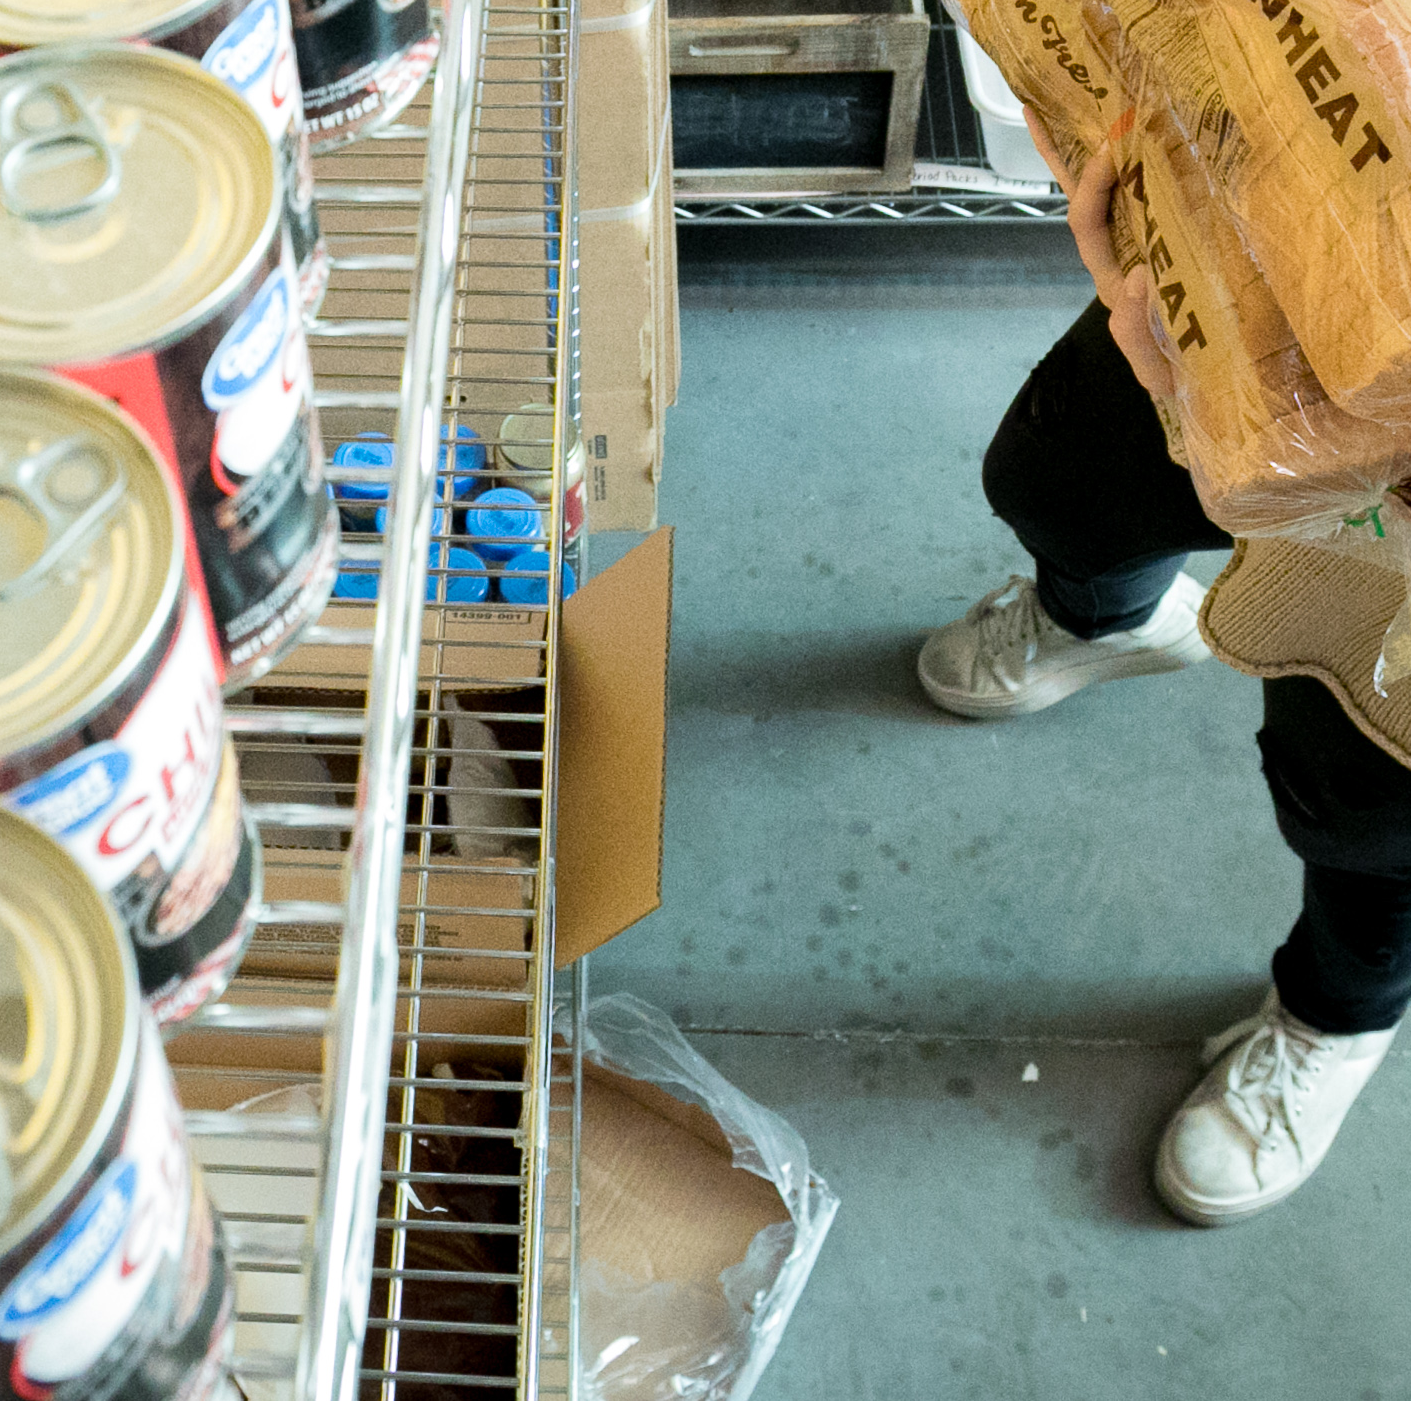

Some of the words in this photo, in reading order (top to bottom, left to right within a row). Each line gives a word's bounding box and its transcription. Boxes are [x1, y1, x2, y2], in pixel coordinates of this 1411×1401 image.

[321, 111, 344, 130] WT
[911, 171, 940, 182] eriod
[946, 171, 979, 183] Packs
